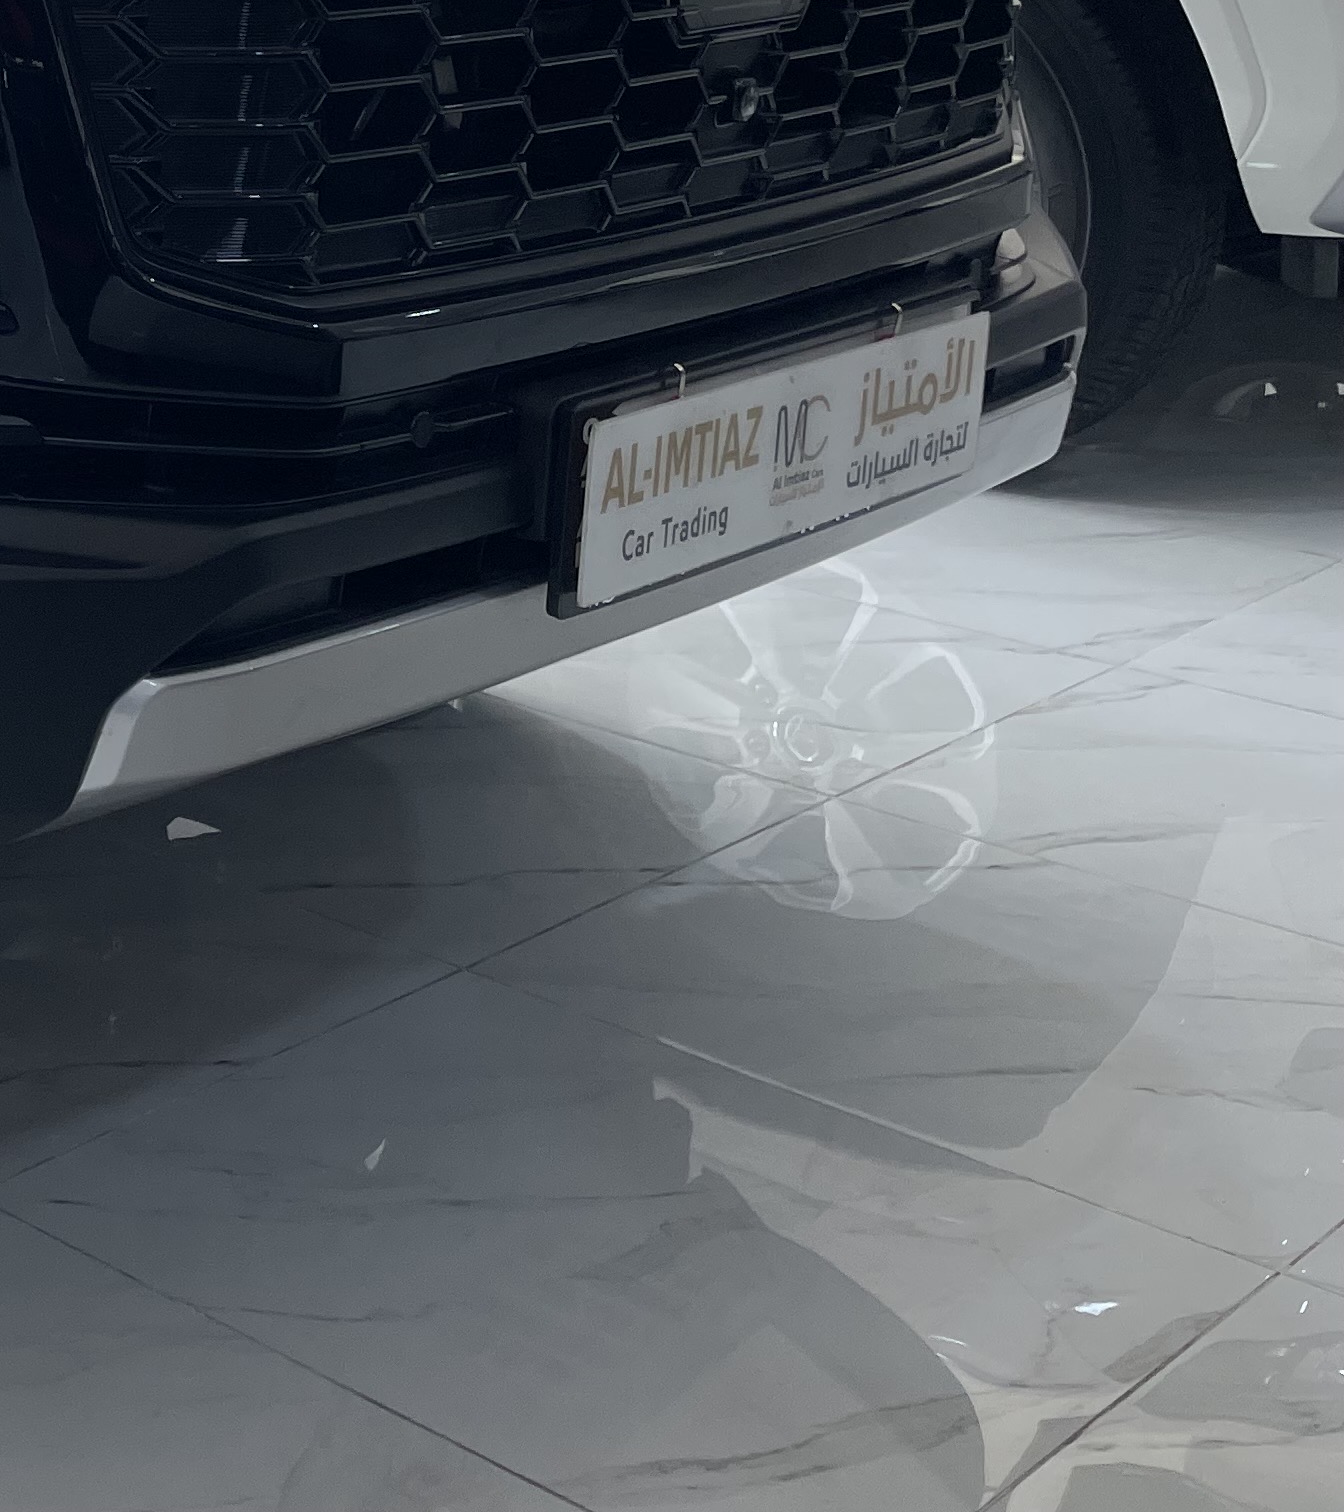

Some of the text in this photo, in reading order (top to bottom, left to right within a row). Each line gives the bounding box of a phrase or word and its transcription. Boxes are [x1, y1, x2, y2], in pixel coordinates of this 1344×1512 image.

[854, 337, 975, 447] الأمتياز
[600, 405, 763, 514] AL-IMTIAZ
[846, 421, 969, 489] لتجارة السيارات
[622, 506, 729, 561] Car Trading
